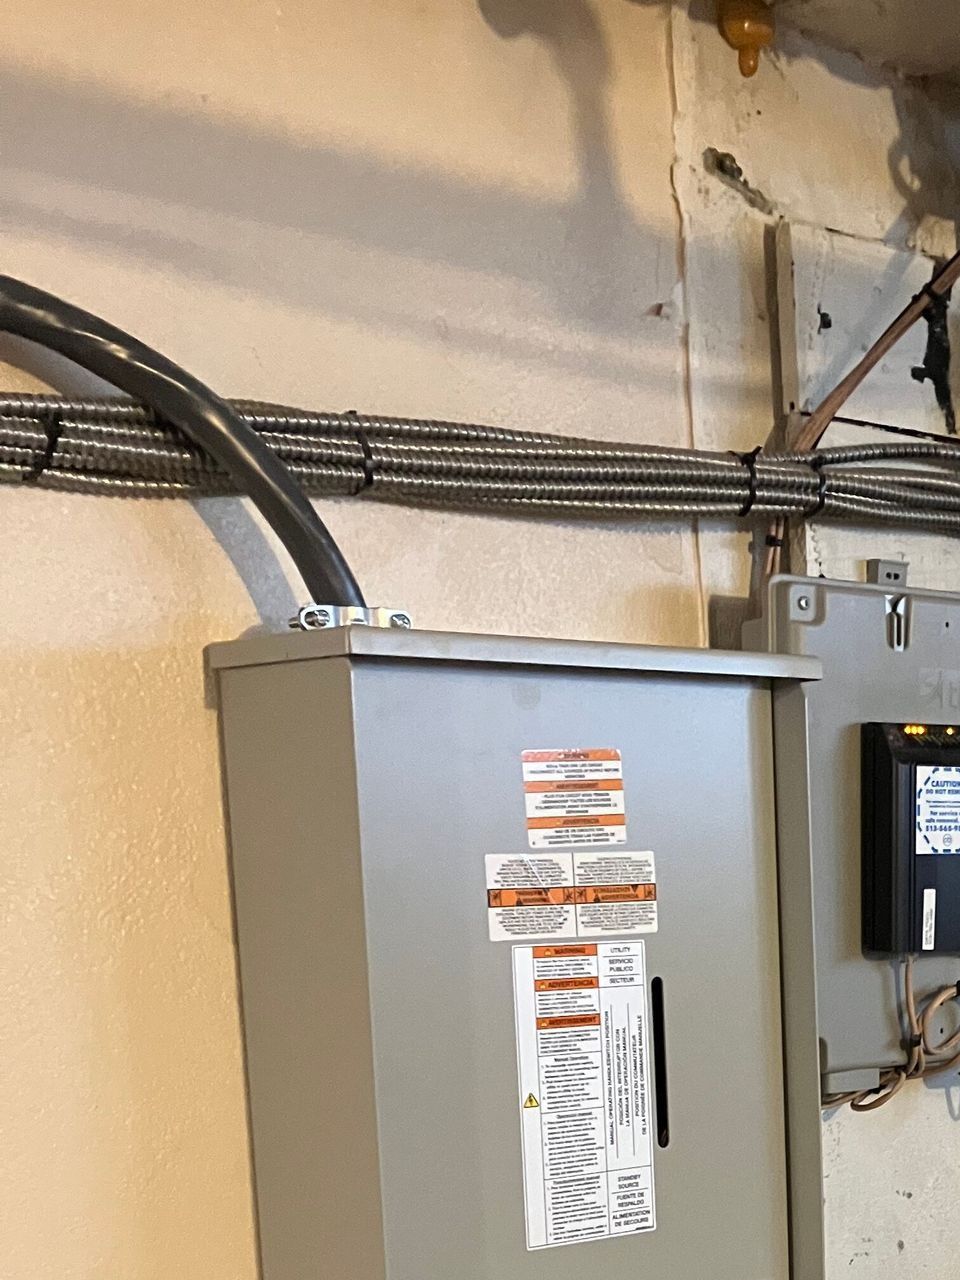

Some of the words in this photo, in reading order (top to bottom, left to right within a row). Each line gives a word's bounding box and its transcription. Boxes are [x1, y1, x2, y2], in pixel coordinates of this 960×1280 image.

[618, 1174, 640, 1182] STANDBY
[618, 1182, 639, 1190] SOURCE
[612, 1210, 650, 1220] ALIMENTATION
[624, 1217, 648, 1226] SECOURS
